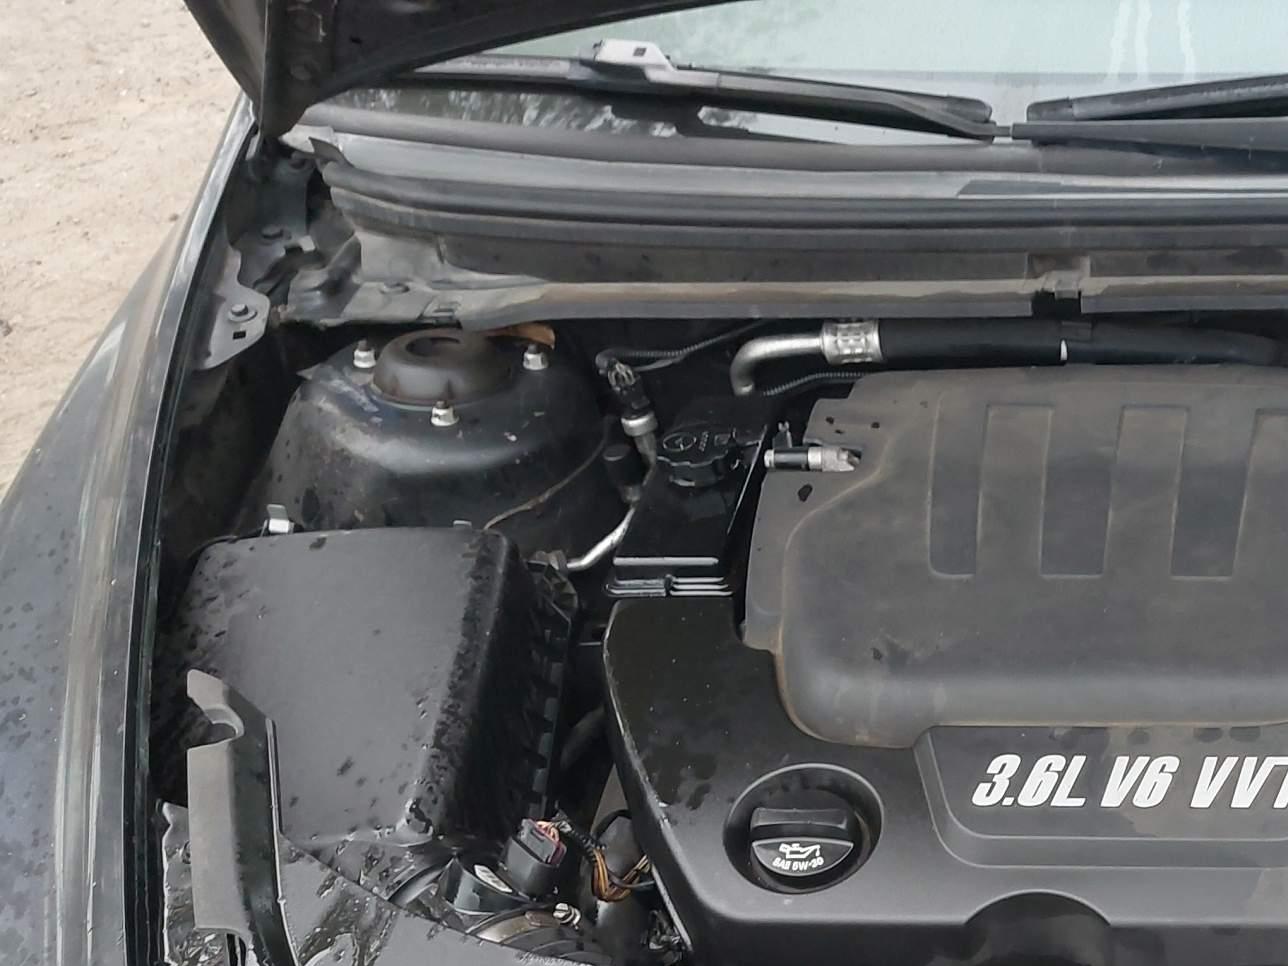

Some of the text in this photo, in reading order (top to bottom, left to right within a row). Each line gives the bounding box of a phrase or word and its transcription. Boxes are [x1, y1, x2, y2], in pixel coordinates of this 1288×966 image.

[971, 754, 1087, 808] 3.6L
[1100, 755, 1180, 808] V6
[772, 856, 824, 871] SAE 5W-30
